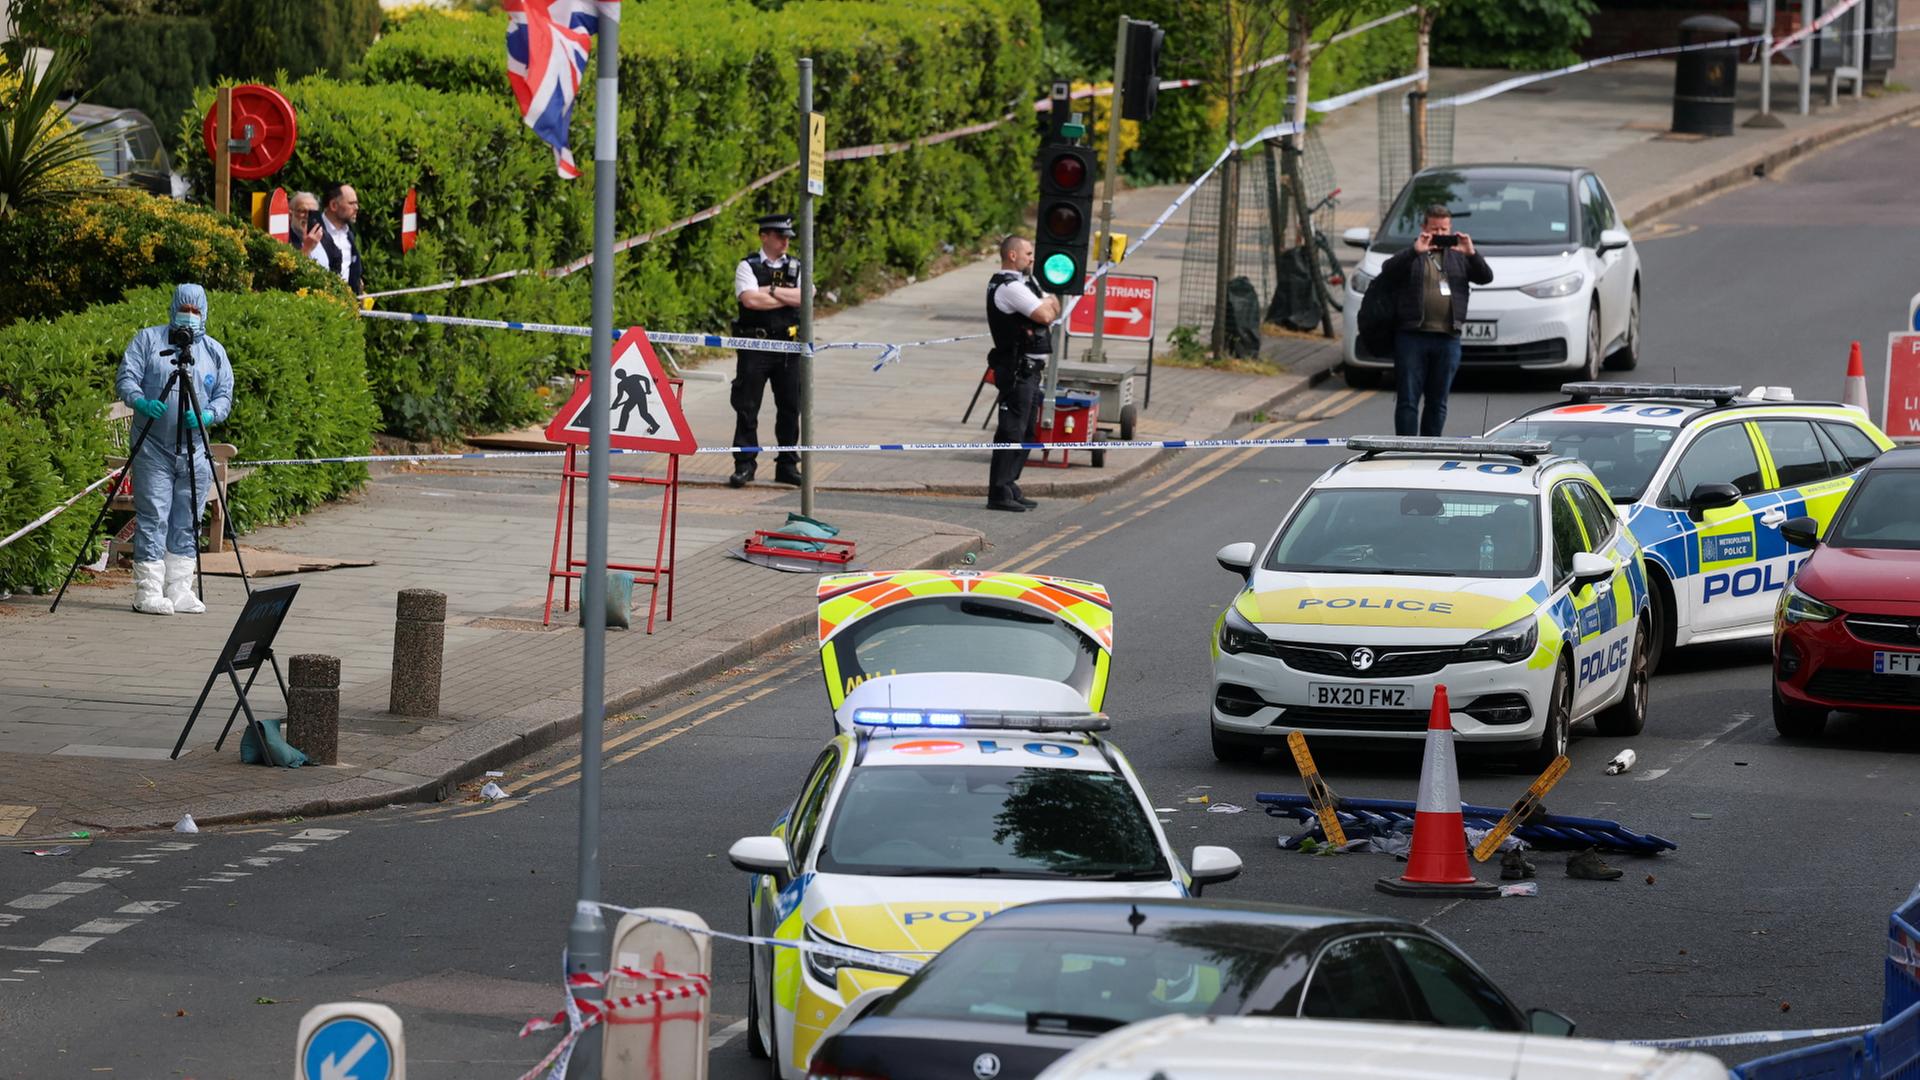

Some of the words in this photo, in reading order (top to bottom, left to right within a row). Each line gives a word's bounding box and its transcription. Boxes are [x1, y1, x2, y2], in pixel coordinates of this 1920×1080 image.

[1466, 325, 1491, 337] KJA
[727, 337, 746, 348] POLICE
[748, 339, 760, 348] LINE
[761, 340, 770, 349] DO
[771, 341, 783, 350] NOT
[783, 342, 802, 351] CROSS
[1724, 546, 1747, 556] POLICE
[1703, 558, 1808, 604] POLI
[1297, 598, 1454, 614] POLICE
[1578, 636, 1628, 689] POLICE
[1318, 687, 1364, 705] BX20
[1369, 689, 1406, 707] FMZ
